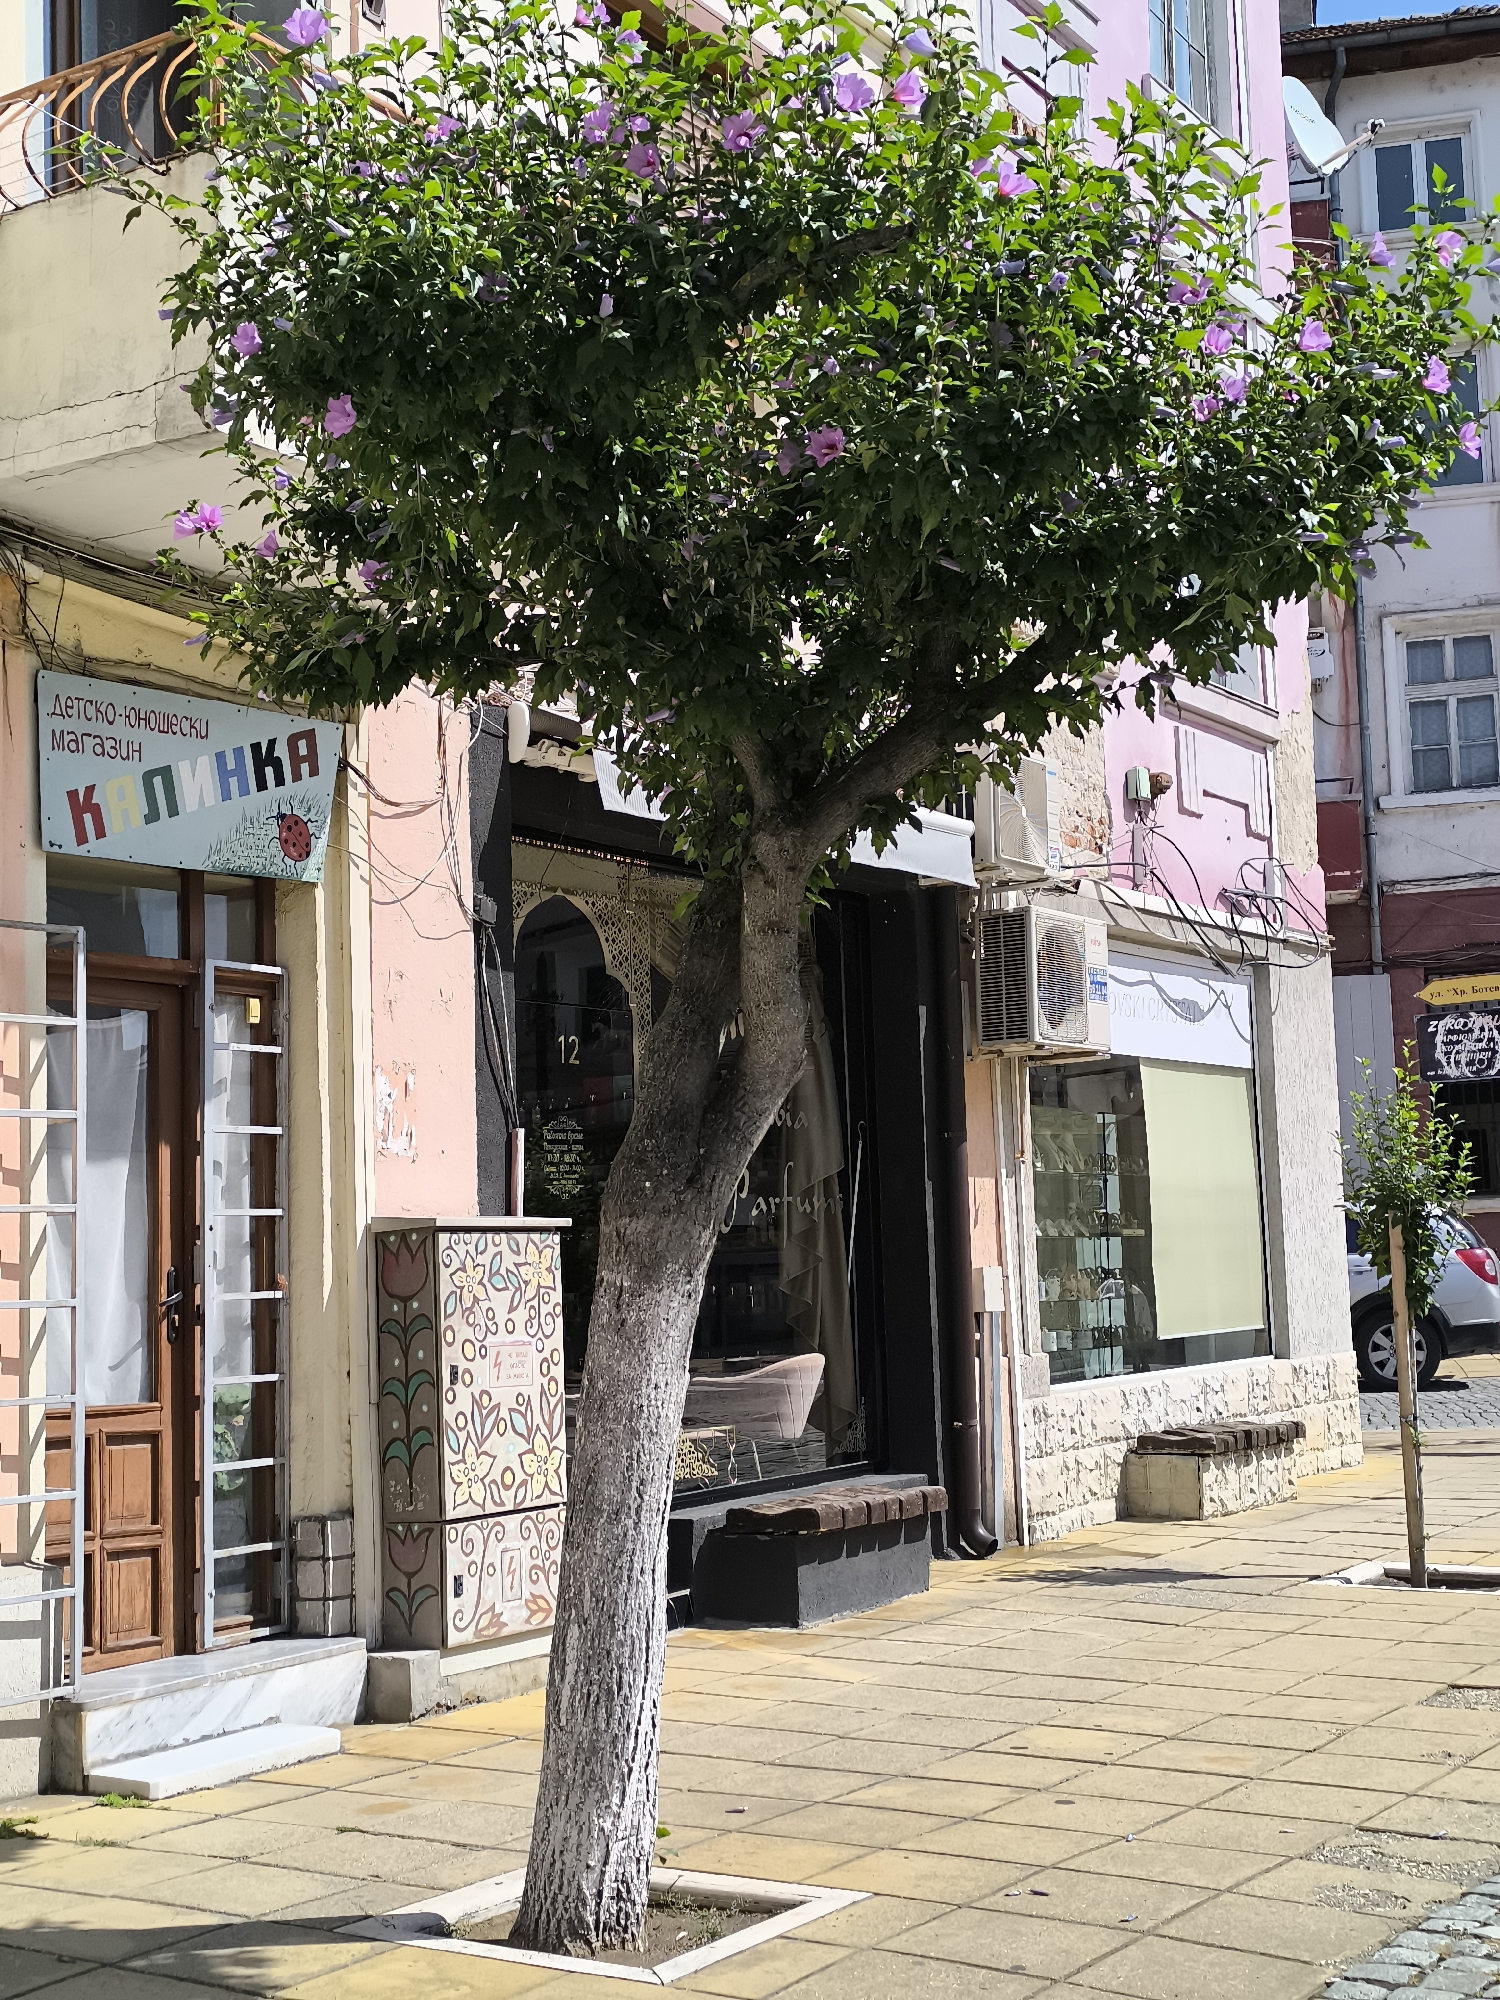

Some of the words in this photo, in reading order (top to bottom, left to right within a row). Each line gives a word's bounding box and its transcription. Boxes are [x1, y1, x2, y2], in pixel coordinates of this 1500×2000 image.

[51, 728, 142, 762] магазин
[66, 728, 320, 847] КАЛИНКА
[1429, 991, 1444, 1000] ул.
[1471, 985, 1500, 995] Ботев
[558, 1034, 580, 1065] 12
